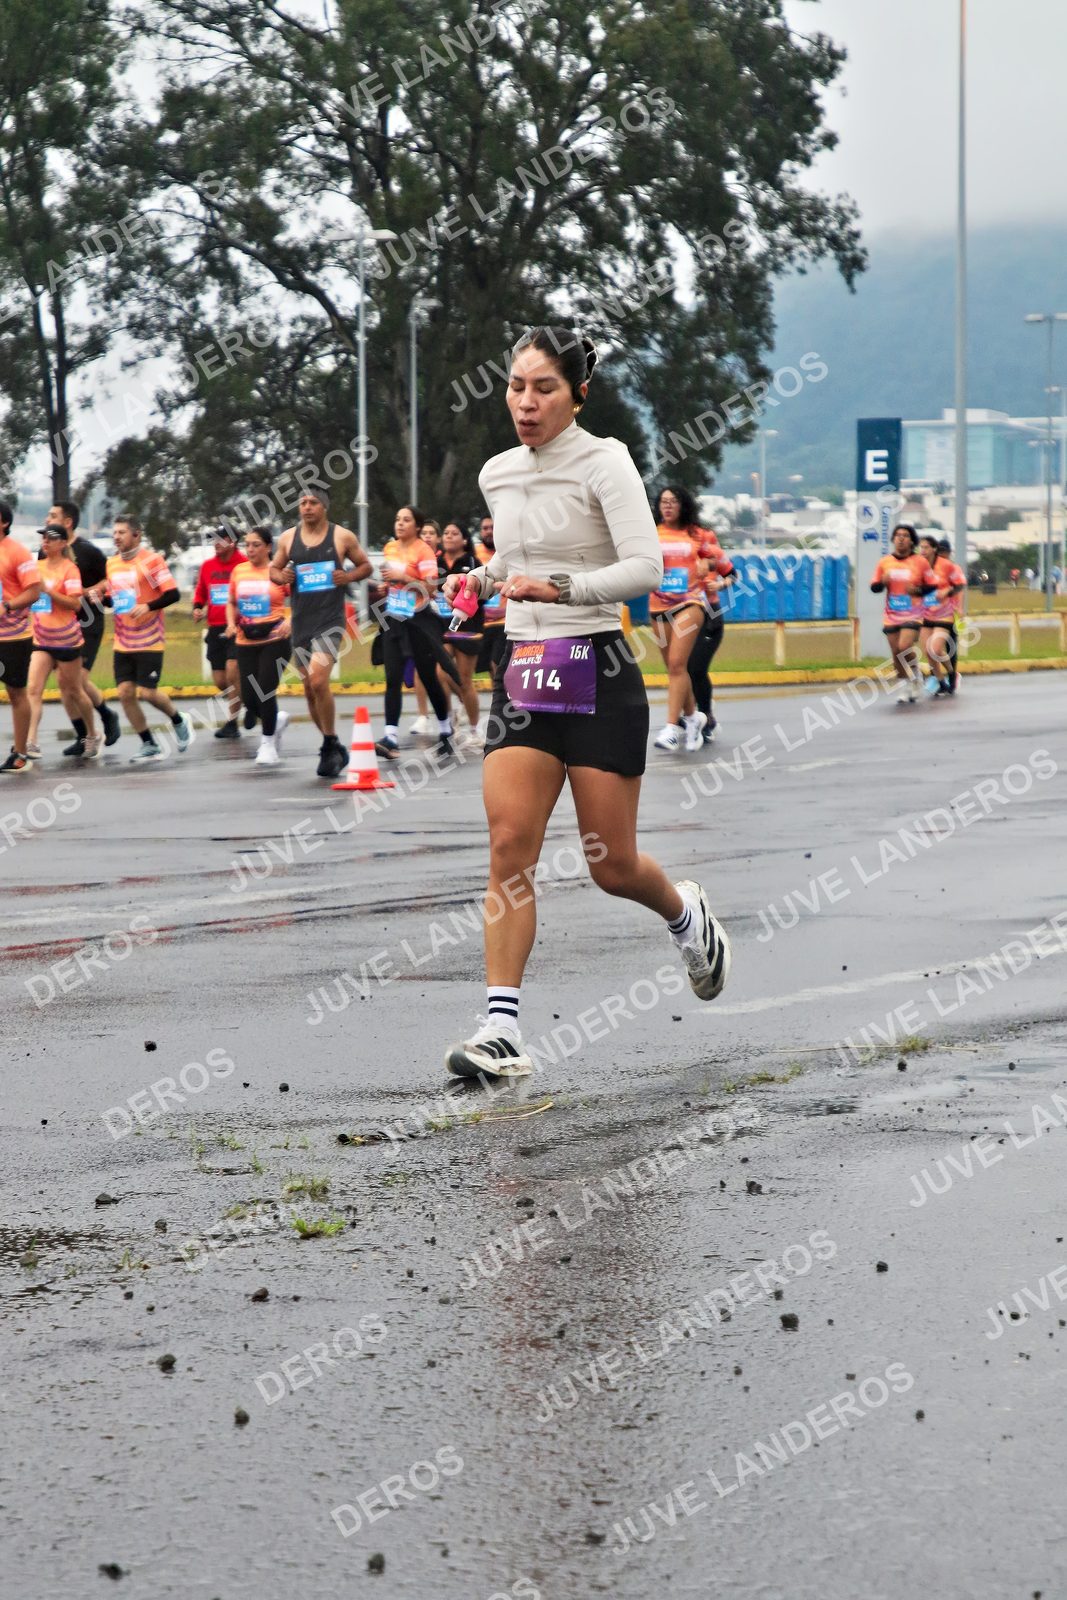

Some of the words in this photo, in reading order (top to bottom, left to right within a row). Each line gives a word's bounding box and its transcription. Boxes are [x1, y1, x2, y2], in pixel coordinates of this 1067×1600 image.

[865, 449, 889, 482] E
[303, 573, 327, 584] 3029
[521, 669, 561, 690] 114
